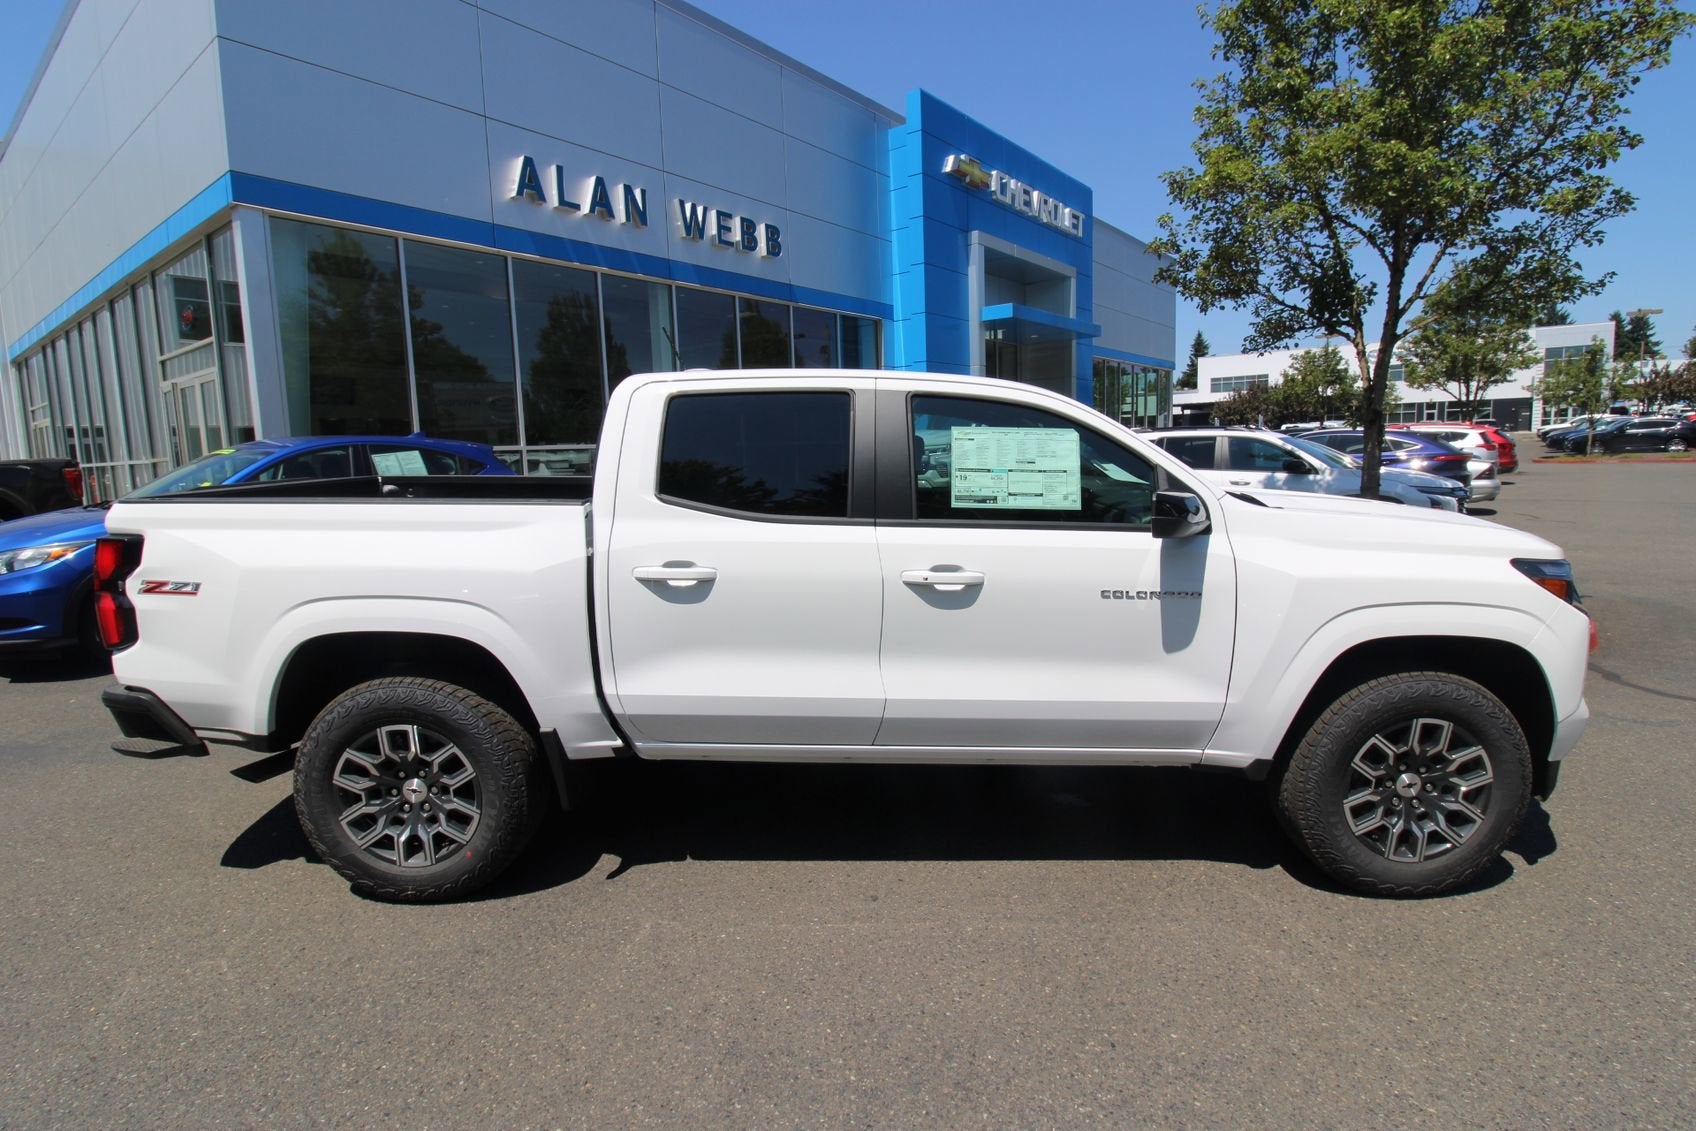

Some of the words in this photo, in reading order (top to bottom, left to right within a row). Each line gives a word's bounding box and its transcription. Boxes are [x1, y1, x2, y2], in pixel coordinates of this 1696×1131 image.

[509, 155, 648, 228] ALAN
[675, 198, 783, 258] WEBB
[991, 170, 1086, 238] CHEVROLET
[137, 580, 202, 596] Z71
